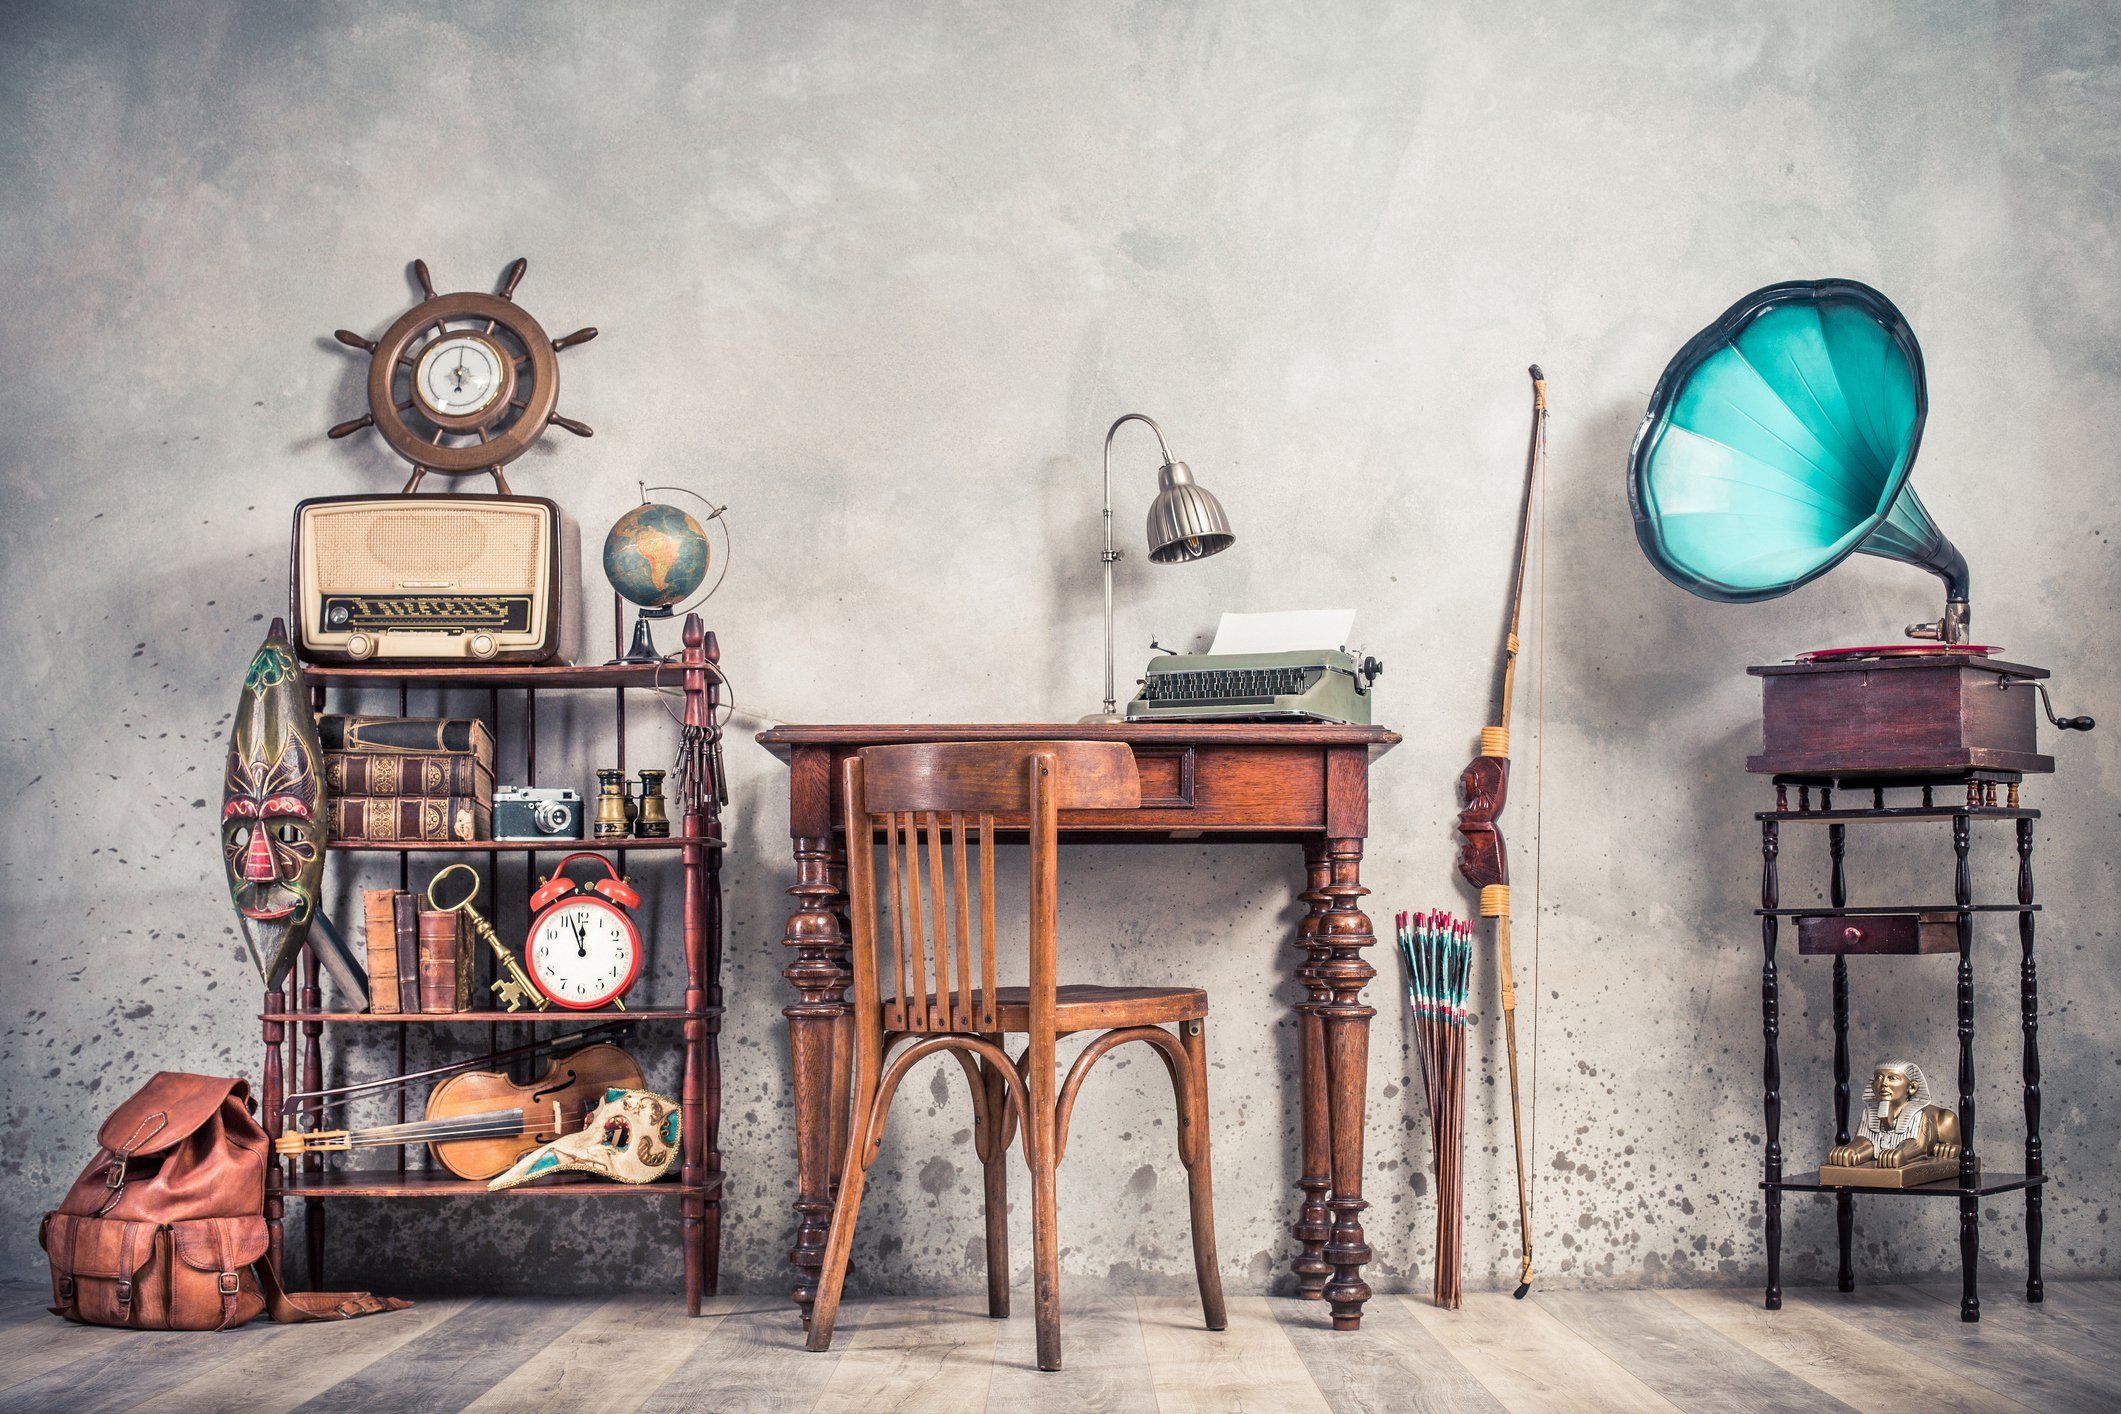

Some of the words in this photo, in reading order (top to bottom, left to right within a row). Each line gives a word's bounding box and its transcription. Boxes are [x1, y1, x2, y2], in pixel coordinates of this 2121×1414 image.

[561, 916, 569, 928] 11
[577, 912, 590, 924] 12
[546, 928, 558, 941] 10
[610, 930, 620, 942] 2
[540, 946, 550, 958] 9
[546, 966, 555, 976] 8
[609, 966, 618, 978] 4
[560, 978, 568, 990] 7
[578, 983, 586, 994] 6
[596, 978, 605, 990] 5
